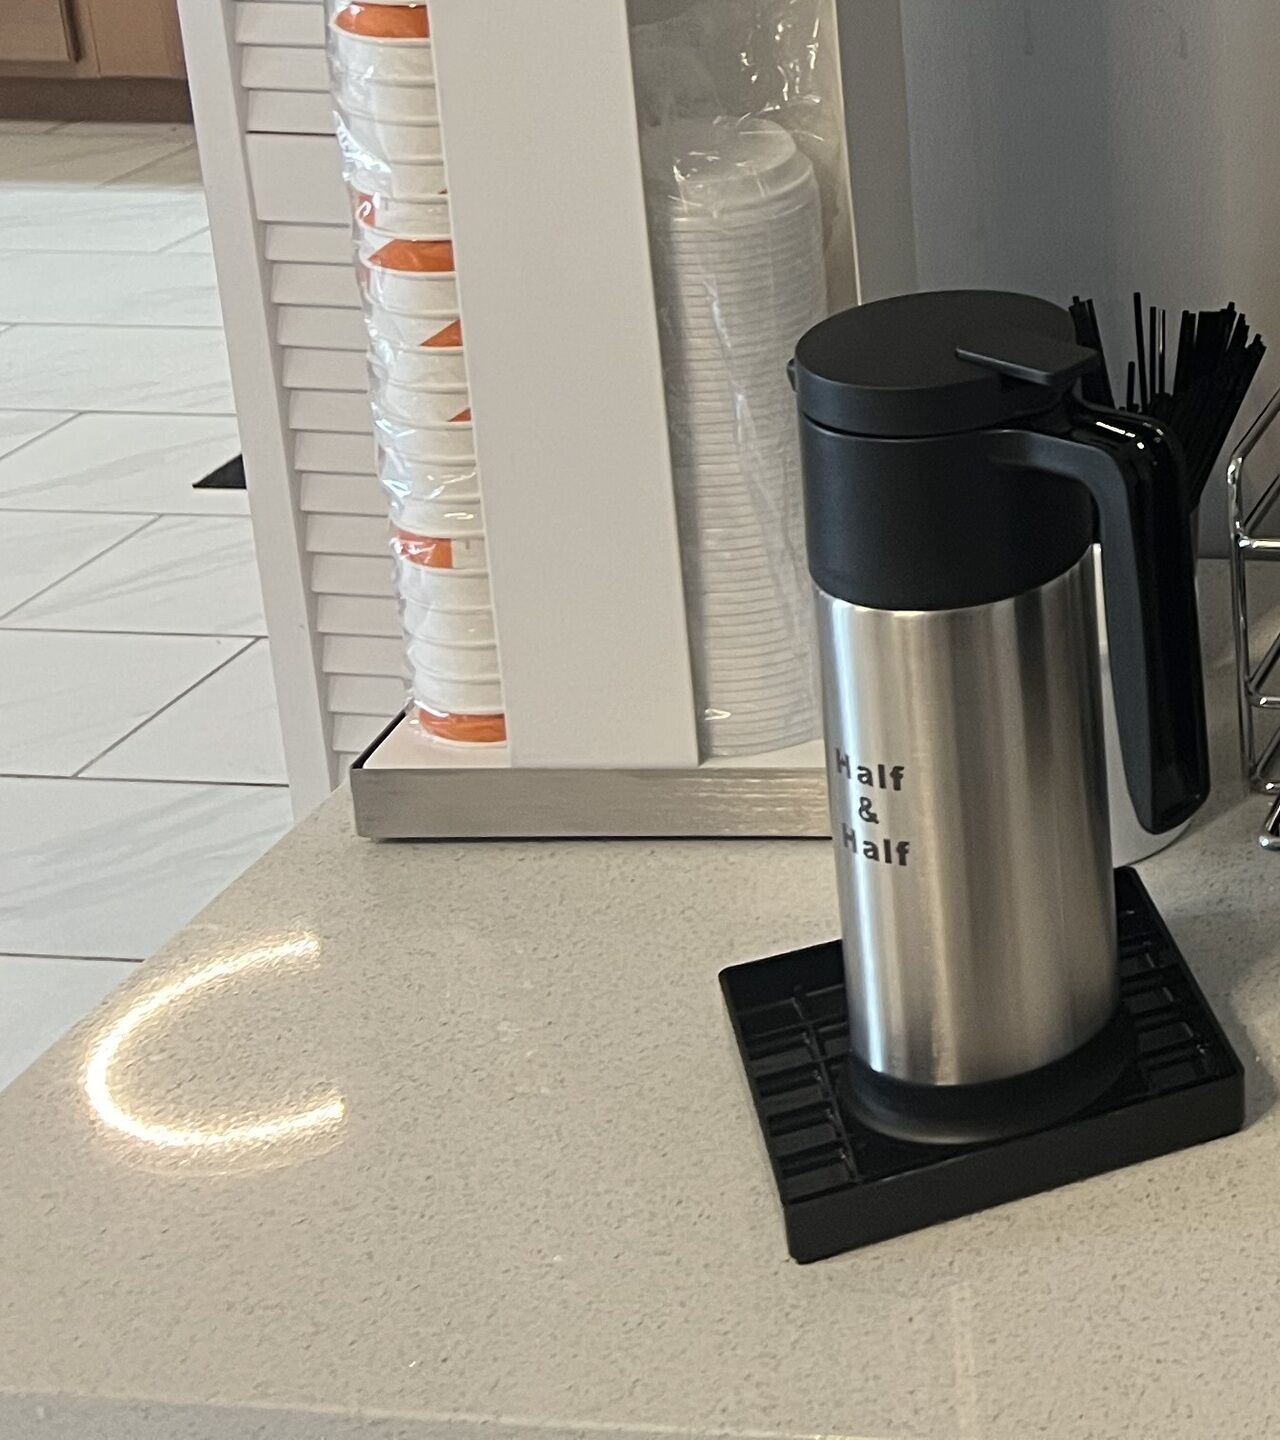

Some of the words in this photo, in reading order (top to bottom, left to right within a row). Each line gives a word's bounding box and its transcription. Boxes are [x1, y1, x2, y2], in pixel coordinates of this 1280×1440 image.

[836, 747, 905, 792] Half
[858, 796, 880, 825] &
[842, 822, 910, 867] Half
